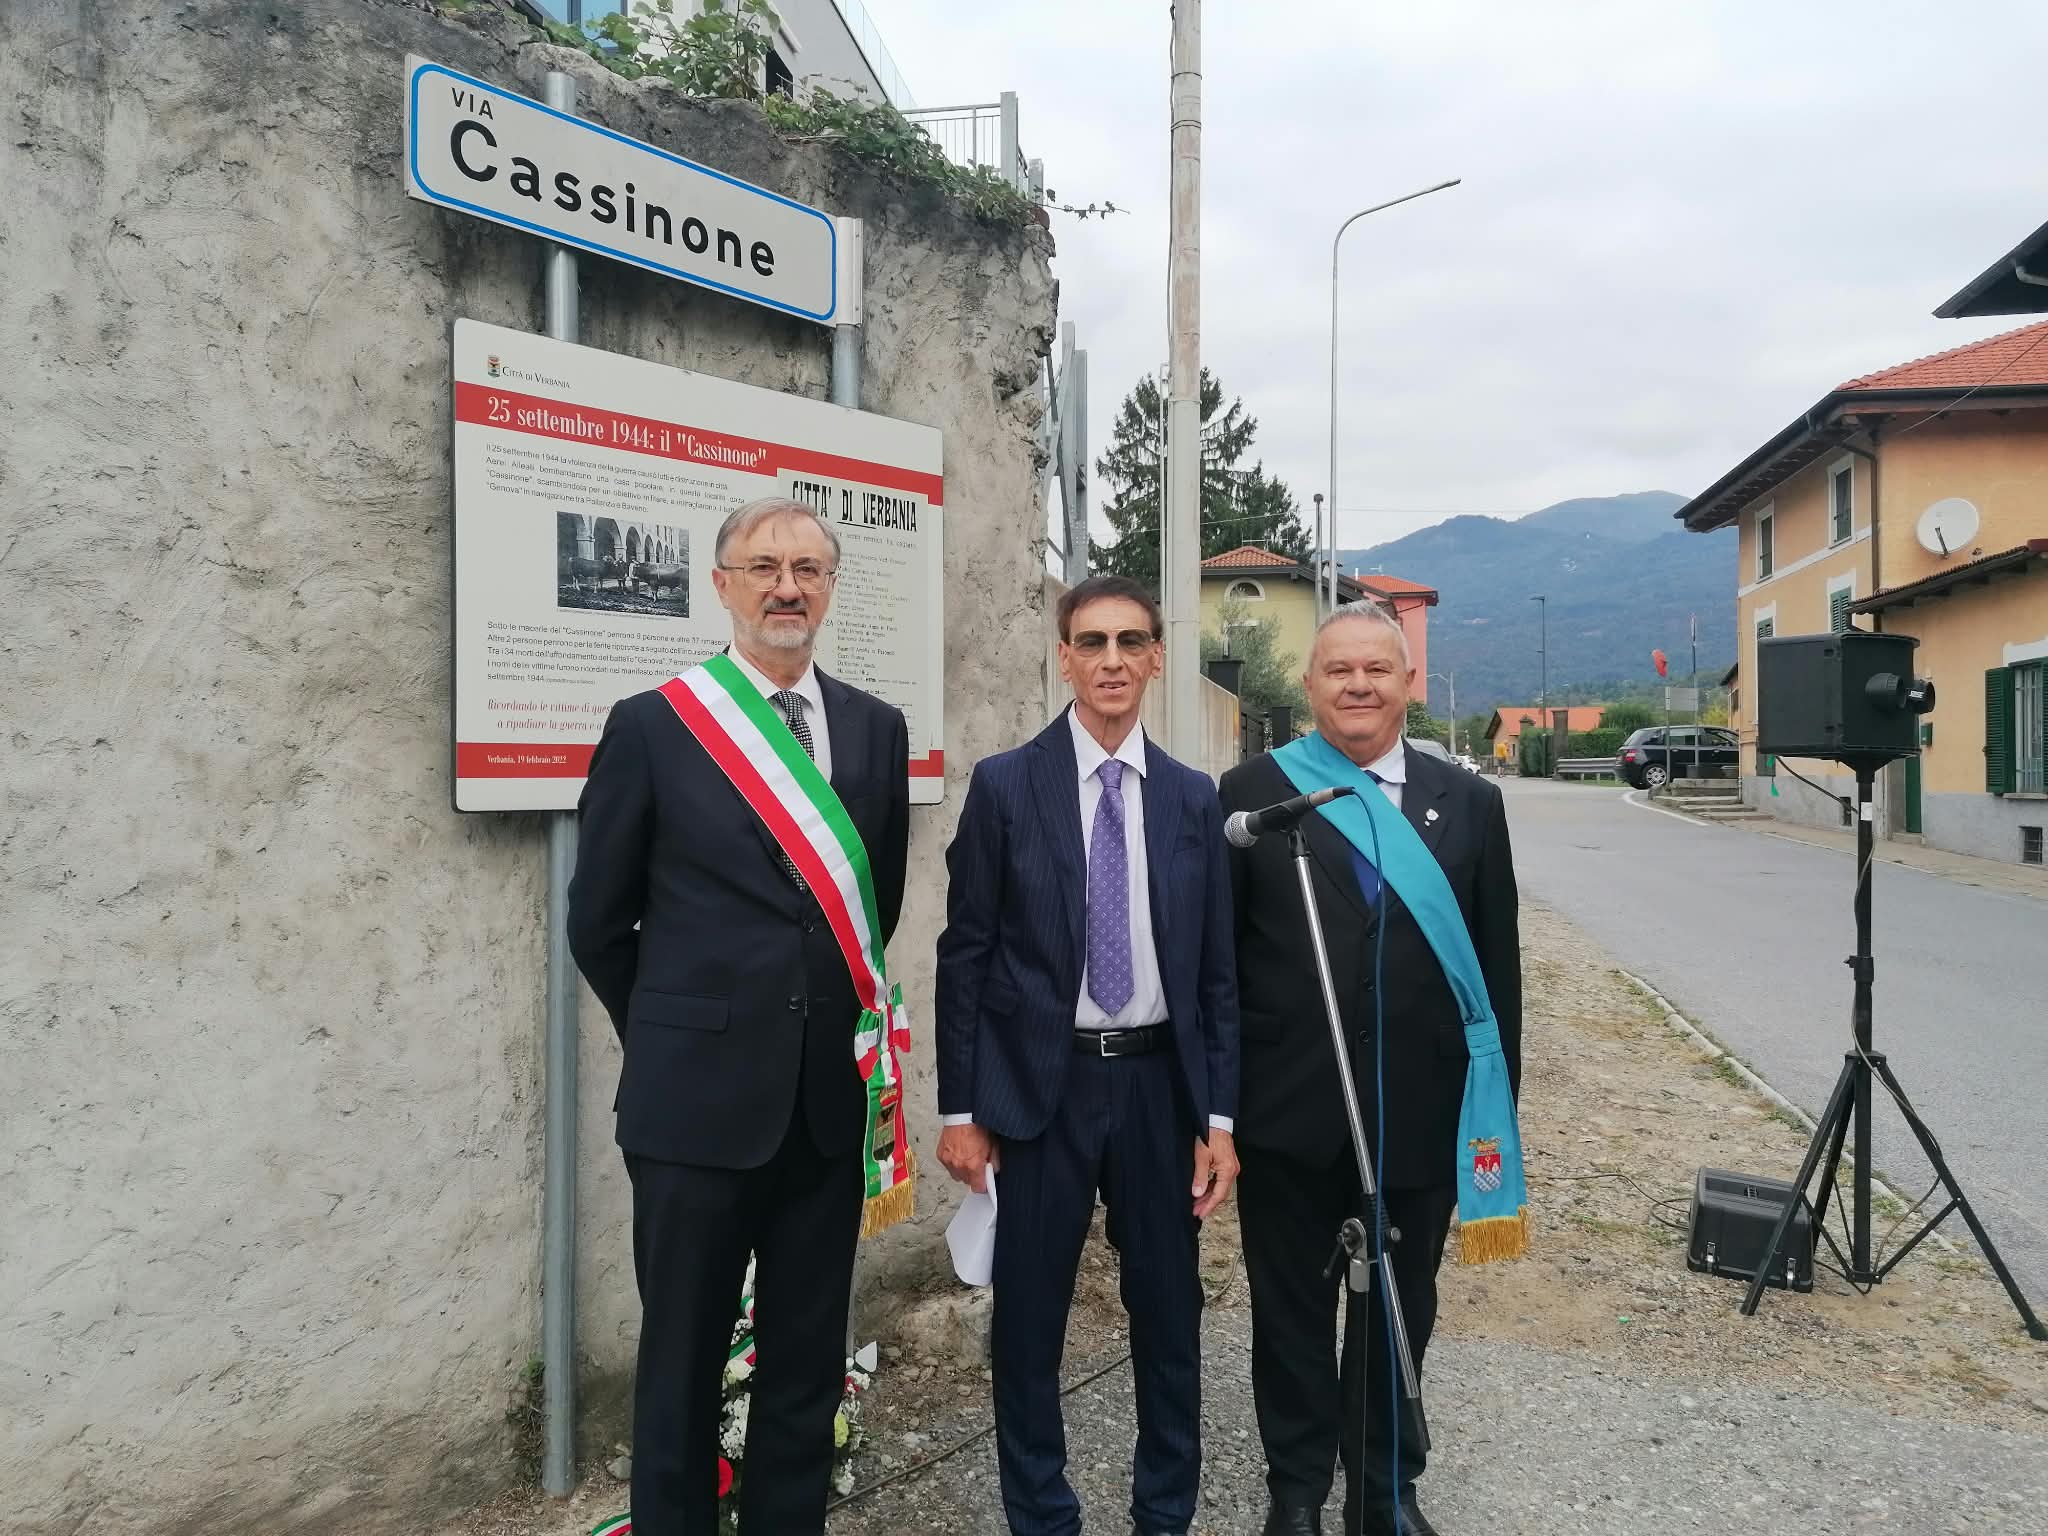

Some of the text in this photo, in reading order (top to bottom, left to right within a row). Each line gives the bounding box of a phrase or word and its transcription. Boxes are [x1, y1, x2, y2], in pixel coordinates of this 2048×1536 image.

[451, 87, 494, 121] VIA
[449, 119, 776, 277] Cassinone
[488, 396, 767, 467] 25 settembre 1944: il "Cassinone"
[491, 444, 502, 453] 25
[502, 447, 540, 459] settembre
[541, 452, 558, 462] 1944
[841, 489, 853, 521] DI
[863, 492, 917, 533] VERBANIA
[487, 621, 507, 630] Sotto
[509, 623, 516, 631] le
[505, 634, 511, 642] 2
[487, 647, 500, 655] Tra
[504, 648, 514, 656] 34
[491, 660, 510, 668] nomi
[531, 662, 555, 670] vittime
[487, 673, 524, 681] settembre
[526, 674, 544, 682] 1944
[487, 700, 538, 711] Ricordando
